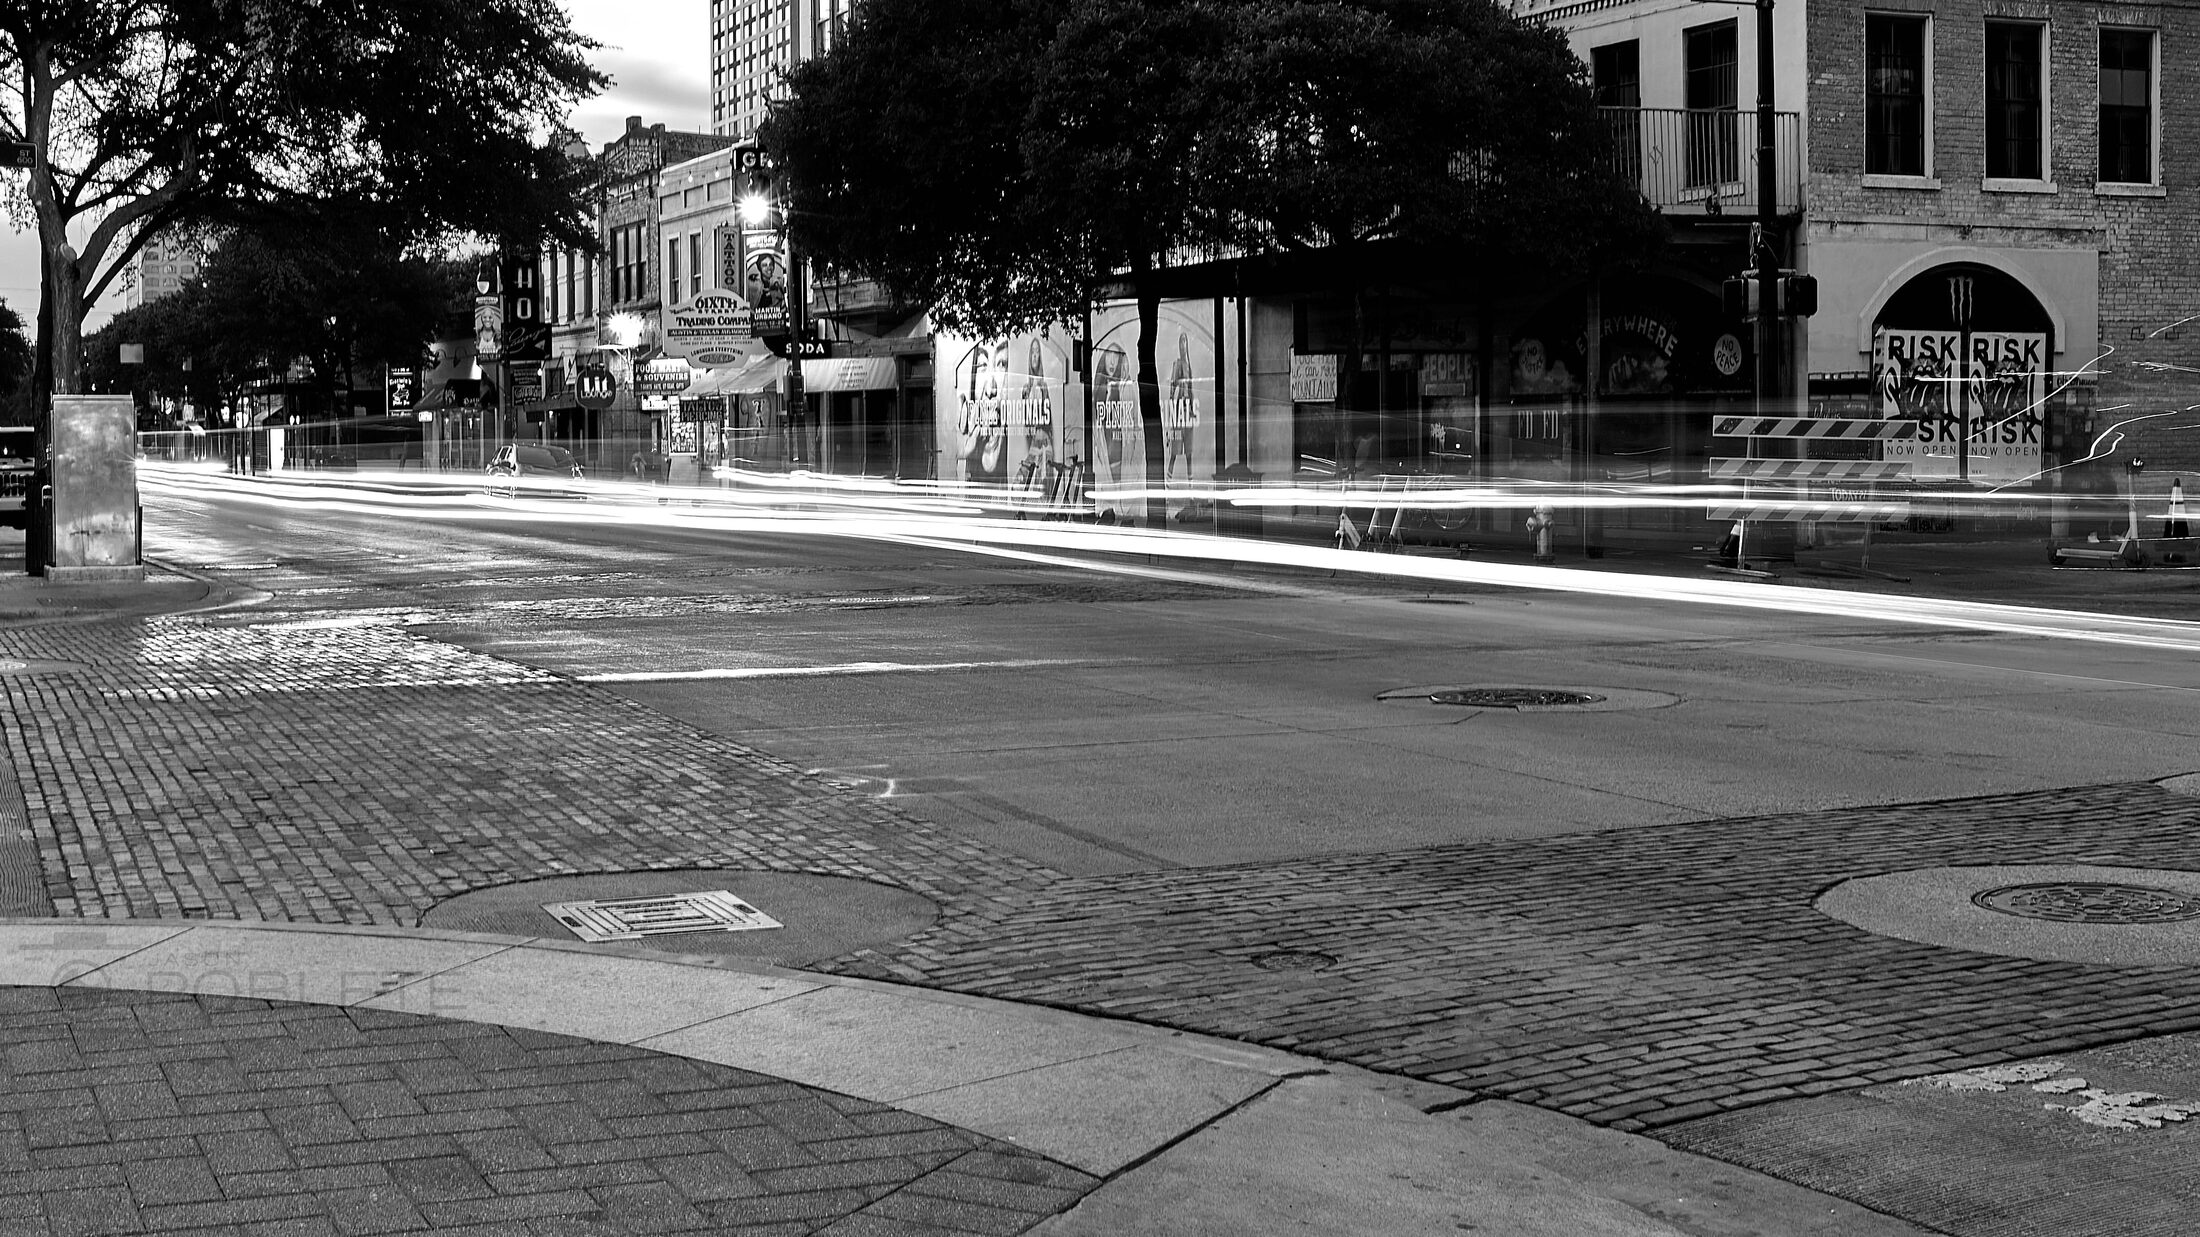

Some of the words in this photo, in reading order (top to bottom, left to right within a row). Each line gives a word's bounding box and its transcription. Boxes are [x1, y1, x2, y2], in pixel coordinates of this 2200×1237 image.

[724, 233, 735, 286] TATTOO
[676, 316, 716, 327] TRADING
[718, 316, 751, 326] COMPA
[754, 312, 782, 320] URBANO
[1721, 340, 1734, 351] NO
[1888, 335, 1957, 361] RISK
[1972, 338, 2041, 364] RISK
[635, 363, 656, 373] FOOD
[1422, 354, 1473, 383] PEOPLE
[1716, 350, 1740, 369] PEACE
[1305, 366, 1319, 378] can
[1000, 399, 1052, 425] ORIGINALS
[1096, 401, 1134, 429] PINK
[1971, 417, 2039, 444] RISK
[1886, 445, 1915, 456] NOW
[1922, 445, 1957, 456] OPEN
[1971, 446, 1999, 457] NOW
[2005, 446, 2039, 457] OPEN
